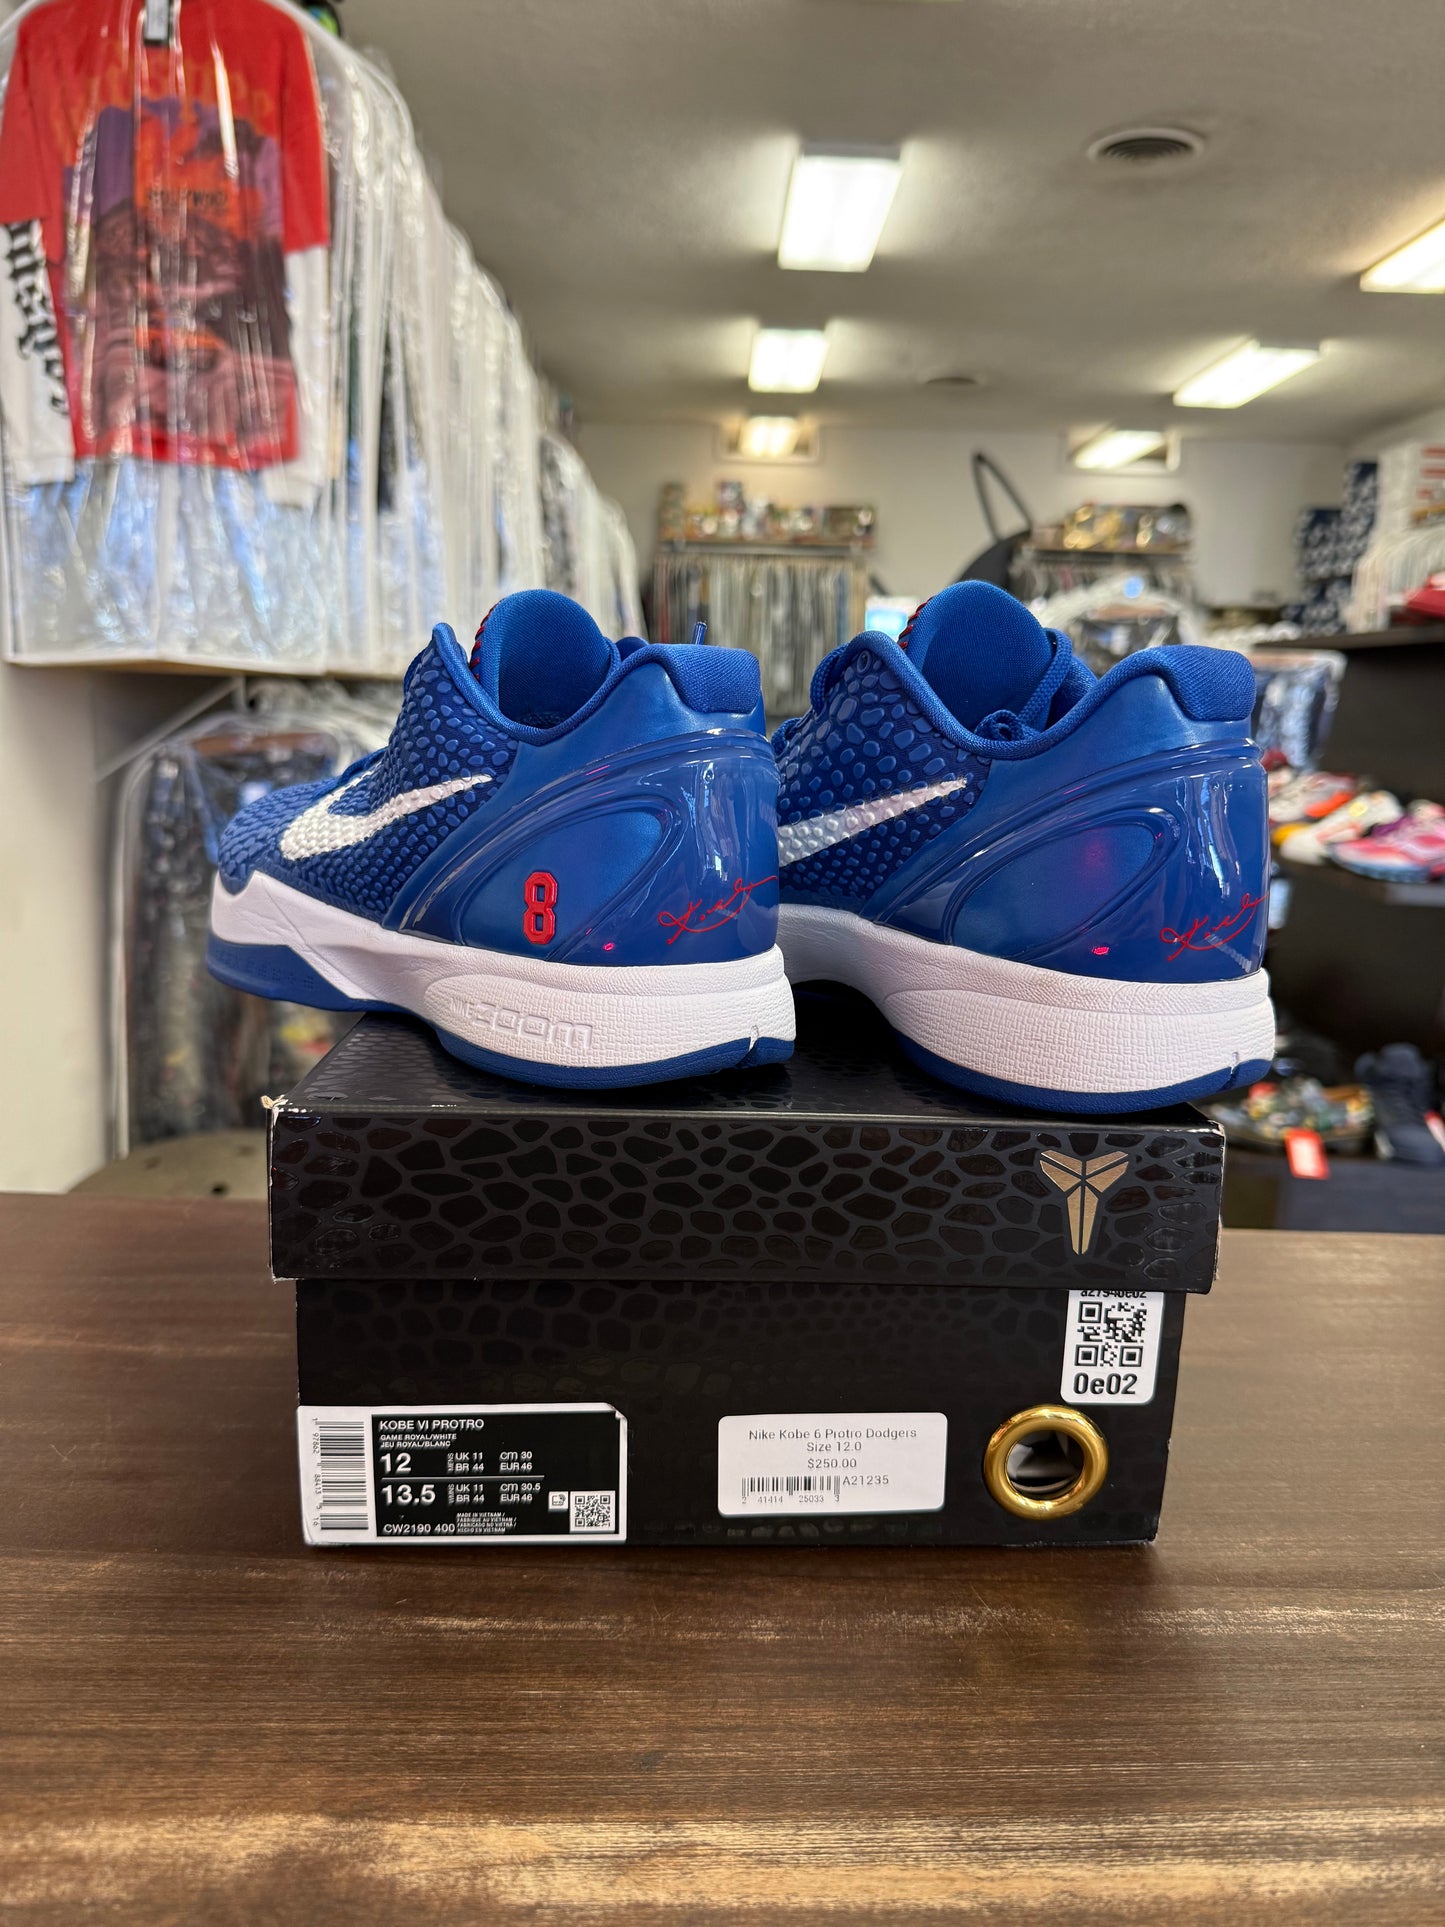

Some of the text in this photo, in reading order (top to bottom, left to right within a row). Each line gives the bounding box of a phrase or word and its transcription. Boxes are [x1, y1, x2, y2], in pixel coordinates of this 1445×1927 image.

[524, 872, 557, 945] 8
[1073, 1372, 1138, 1395] 0e02
[379, 1418, 485, 1431] KOBE VI PROTRO
[749, 1429, 775, 1440] Nike
[779, 1428, 810, 1439] Kobe
[814, 1428, 821, 1439] 6
[396, 1440, 451, 1448] ROYAL/BLANC
[806, 1441, 862, 1452] Size 12.0
[455, 1452, 483, 1460] UK 11
[521, 1451, 533, 1459] 30
[380, 1452, 412, 1473] 12
[455, 1462, 484, 1471] BR 44
[500, 1462, 533, 1471] EUR 46
[807, 1458, 857, 1469] $250.00
[842, 1475, 889, 1485] A21235
[456, 1483, 483, 1492] UK 11
[521, 1483, 541, 1491] 30.5
[381, 1484, 436, 1505] 13.5
[456, 1494, 485, 1502] BR 44
[500, 1493, 533, 1502] EUR 46
[757, 1495, 783, 1503] 41414
[799, 1494, 824, 1503] 25033
[834, 1494, 840, 1502] 3
[383, 1523, 456, 1533] CW2190 400
